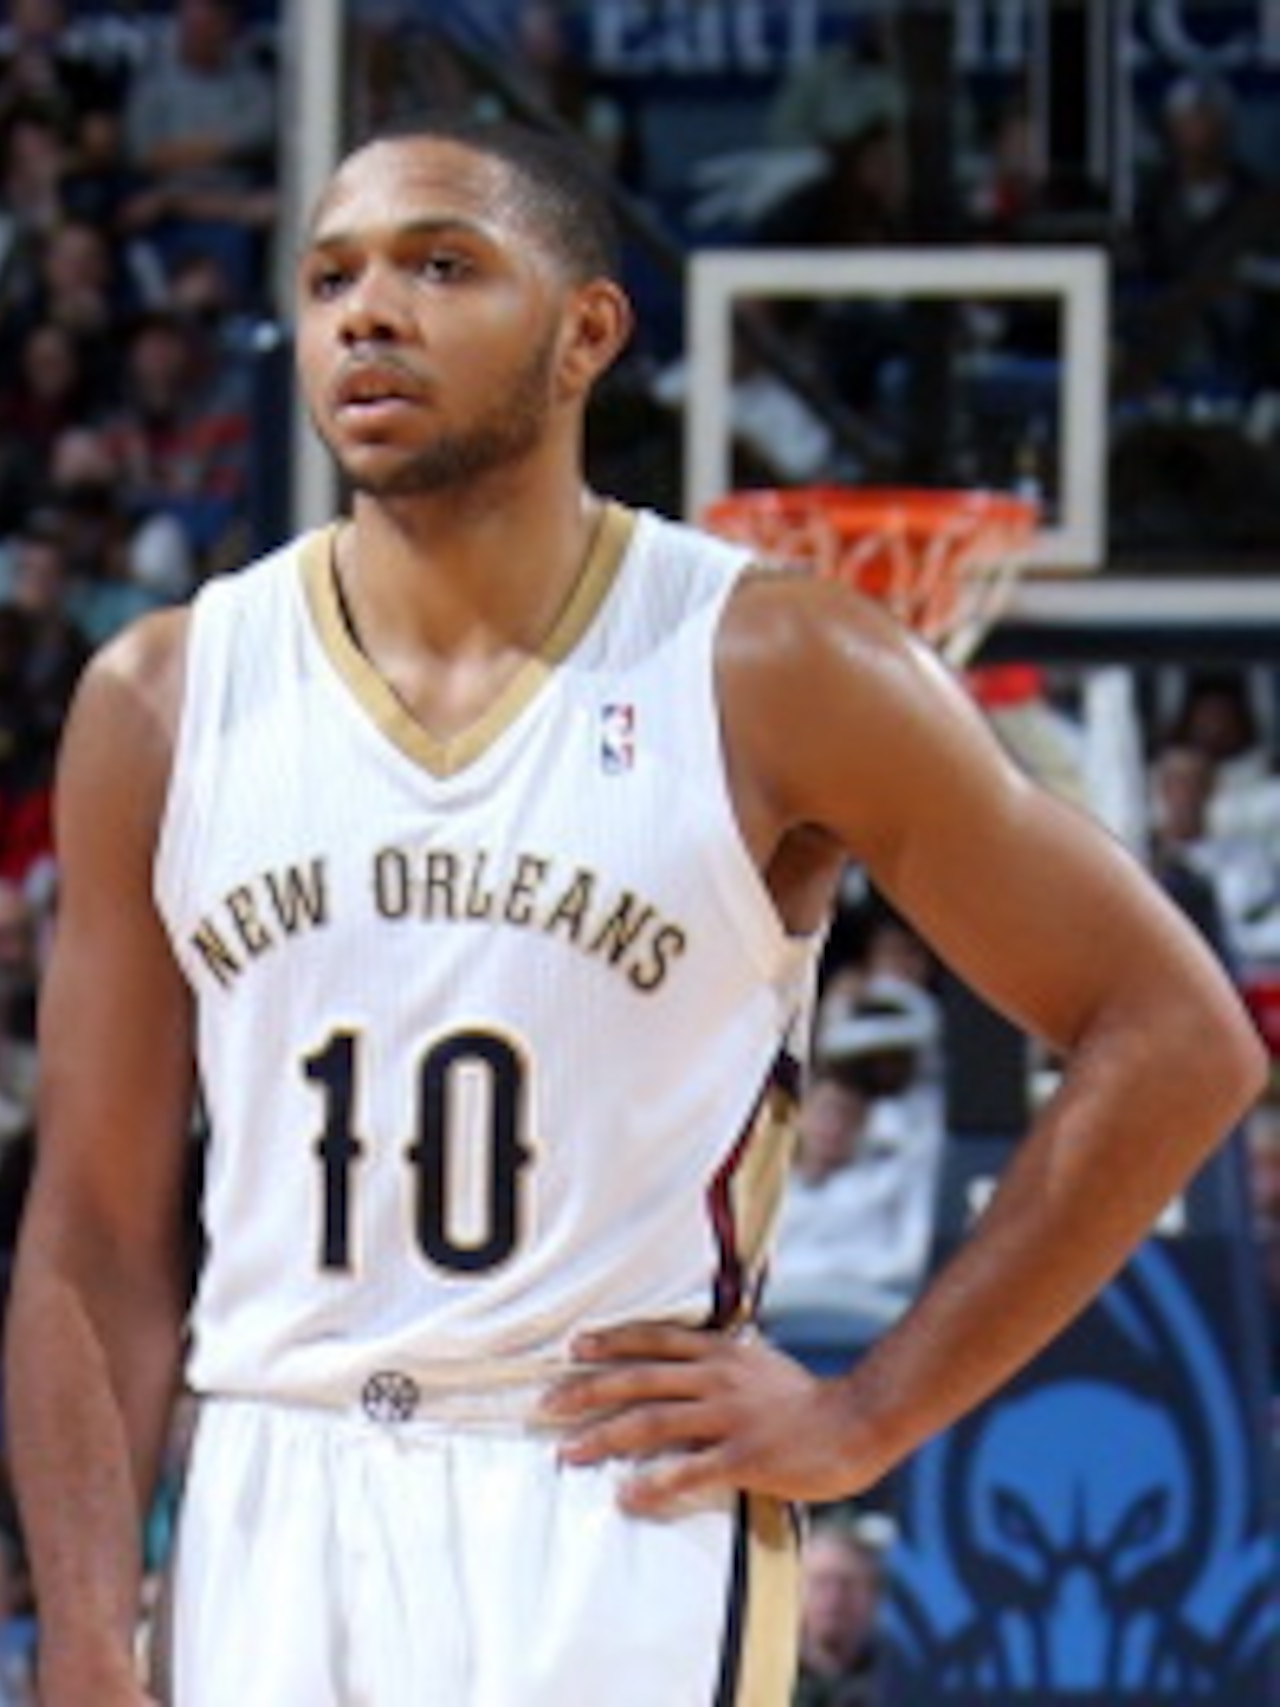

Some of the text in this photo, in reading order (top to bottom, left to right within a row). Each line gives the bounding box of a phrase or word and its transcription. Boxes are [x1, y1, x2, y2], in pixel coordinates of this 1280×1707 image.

[190, 846, 688, 993] NEW ORLEANS
[299, 1026, 534, 1278] 10
